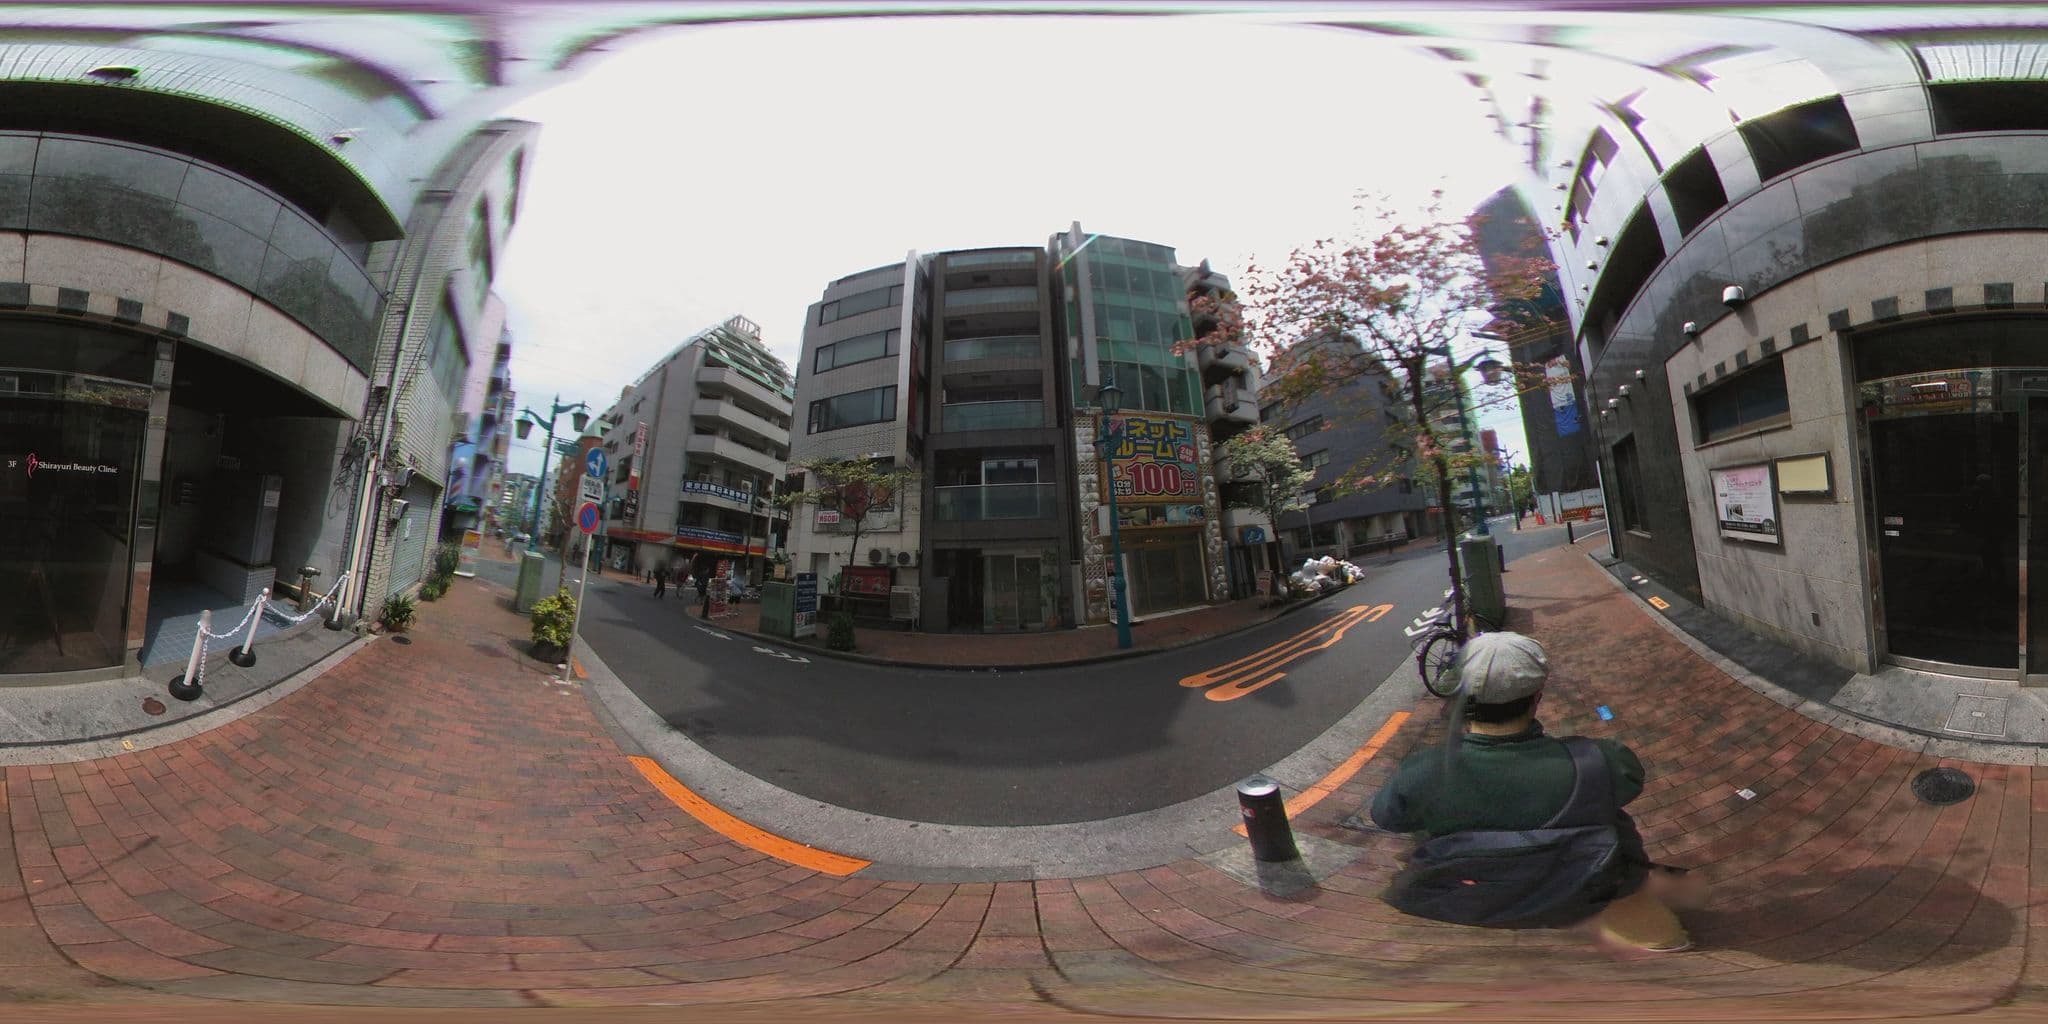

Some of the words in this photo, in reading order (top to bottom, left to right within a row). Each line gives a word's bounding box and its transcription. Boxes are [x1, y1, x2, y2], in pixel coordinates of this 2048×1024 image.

[1127, 419, 1185, 440] ネット
[1115, 438, 1175, 459] ルーム
[8, 460, 17, 468] 3F
[38, 461, 72, 472] Shirayuri
[73, 463, 97, 474] Beauty
[97, 465, 118, 474] Clinic
[1126, 461, 1182, 496] 100
